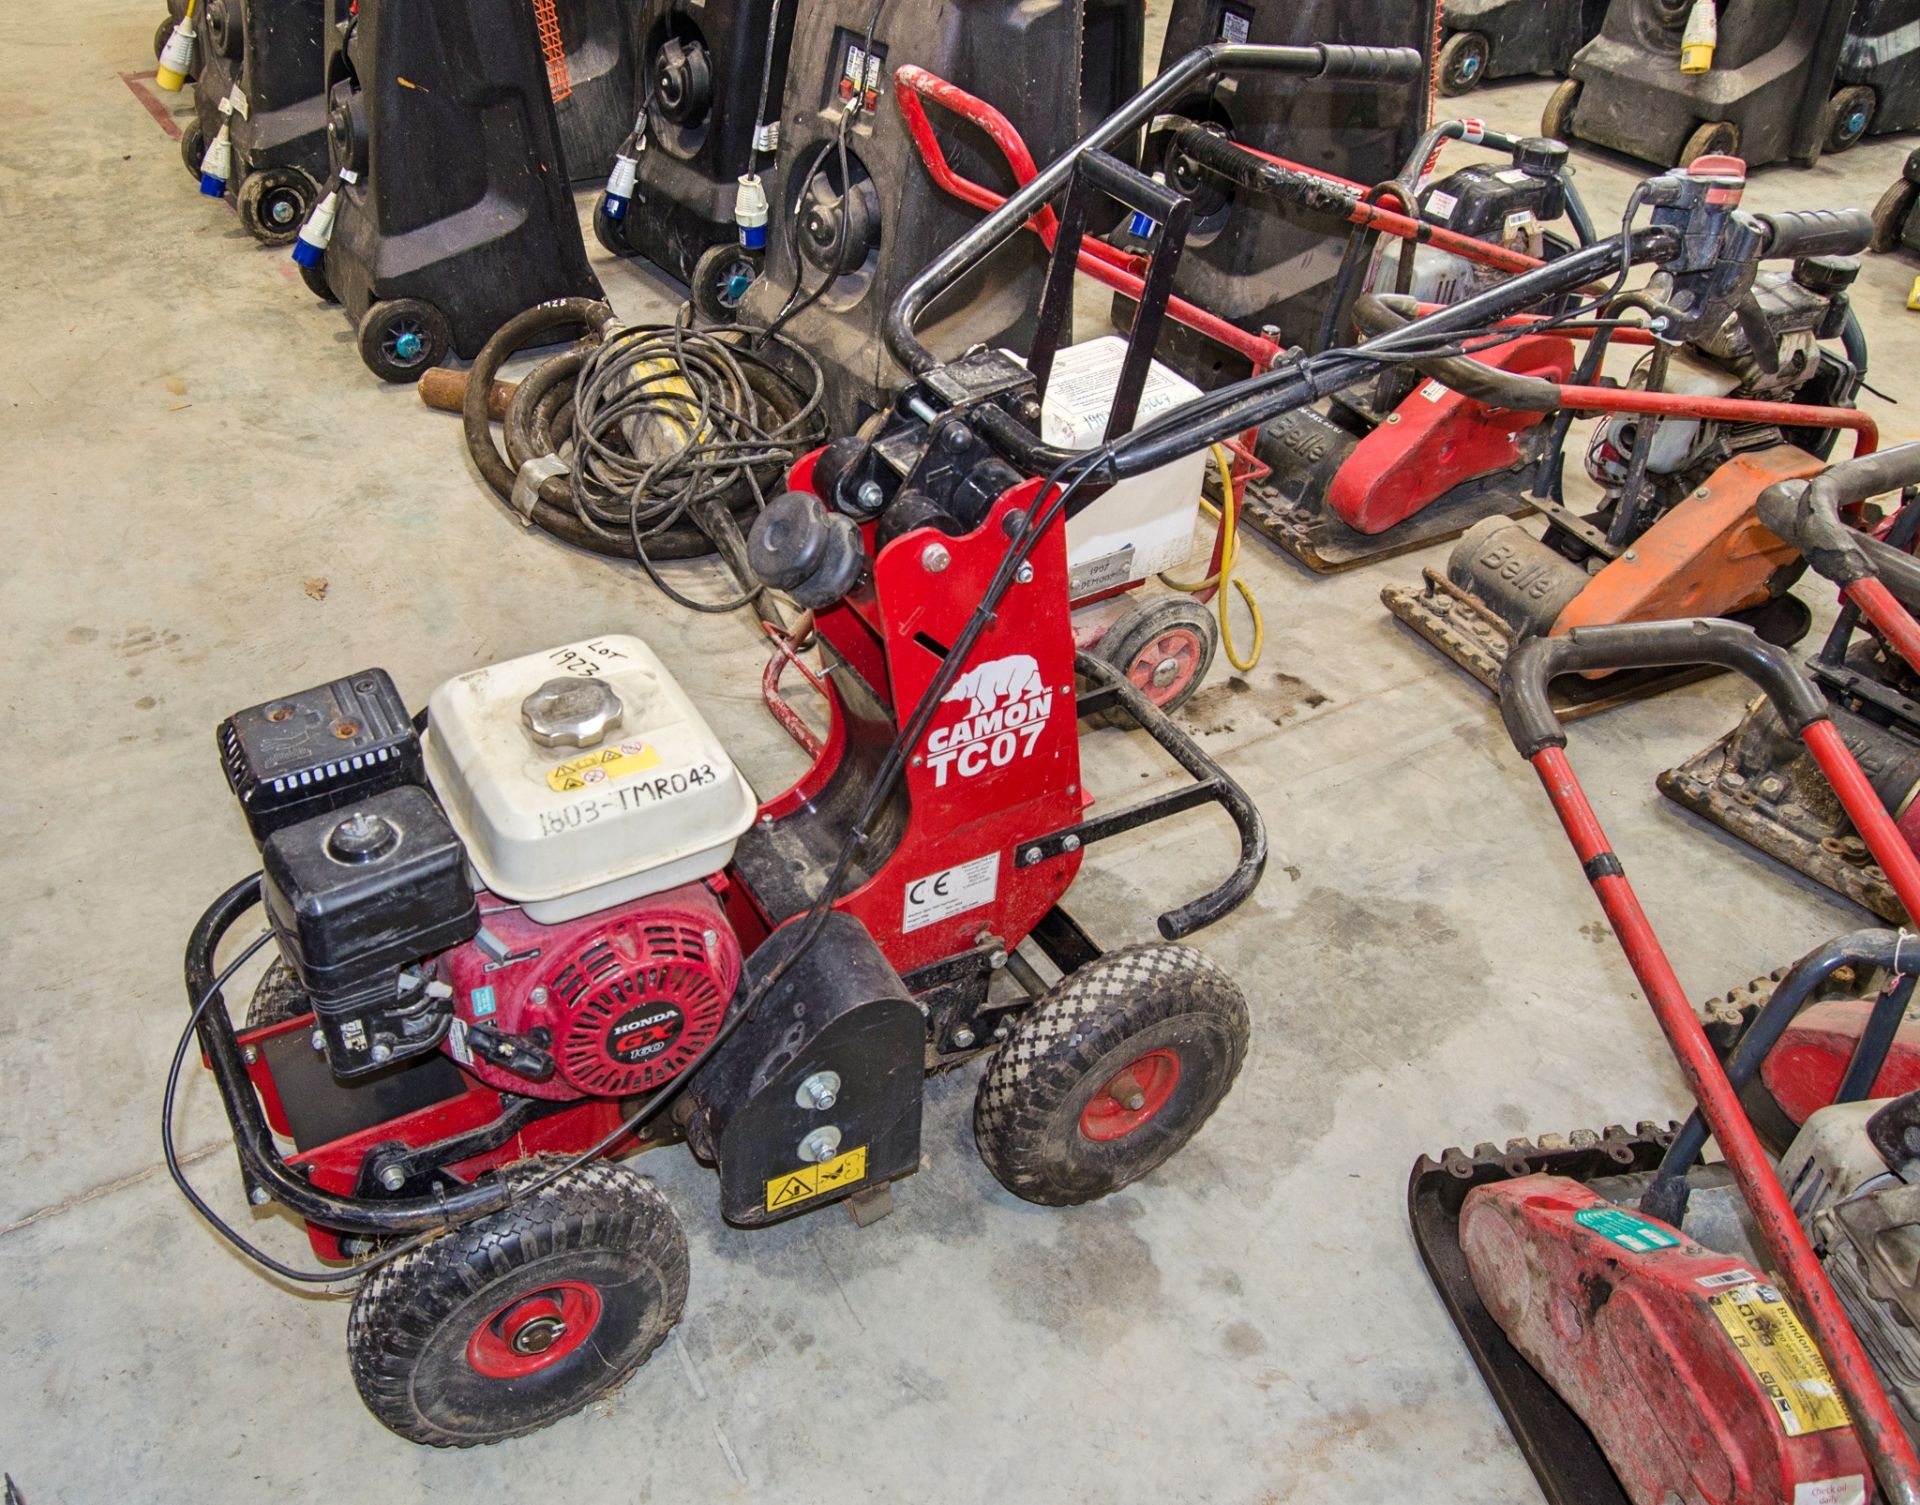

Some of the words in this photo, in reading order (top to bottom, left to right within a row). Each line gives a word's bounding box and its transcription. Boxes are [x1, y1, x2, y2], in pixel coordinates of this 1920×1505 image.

[1267, 415, 1327, 463] Belle
[1479, 545, 1551, 599] Belle
[549, 648, 600, 677] 1923
[927, 692, 1053, 754] CAMON
[927, 720, 1046, 788] TC07
[539, 764, 717, 837] 1803-TMR043
[613, 1009, 680, 1036] HONDA
[616, 1019, 677, 1053] GX
[630, 1041, 665, 1060] 160
[1777, 1307, 1811, 1352] Brandon
[1809, 1352, 1828, 1377] Hire
[1812, 1484, 1836, 1497] Check
[1837, 1482, 1847, 1493] oil
